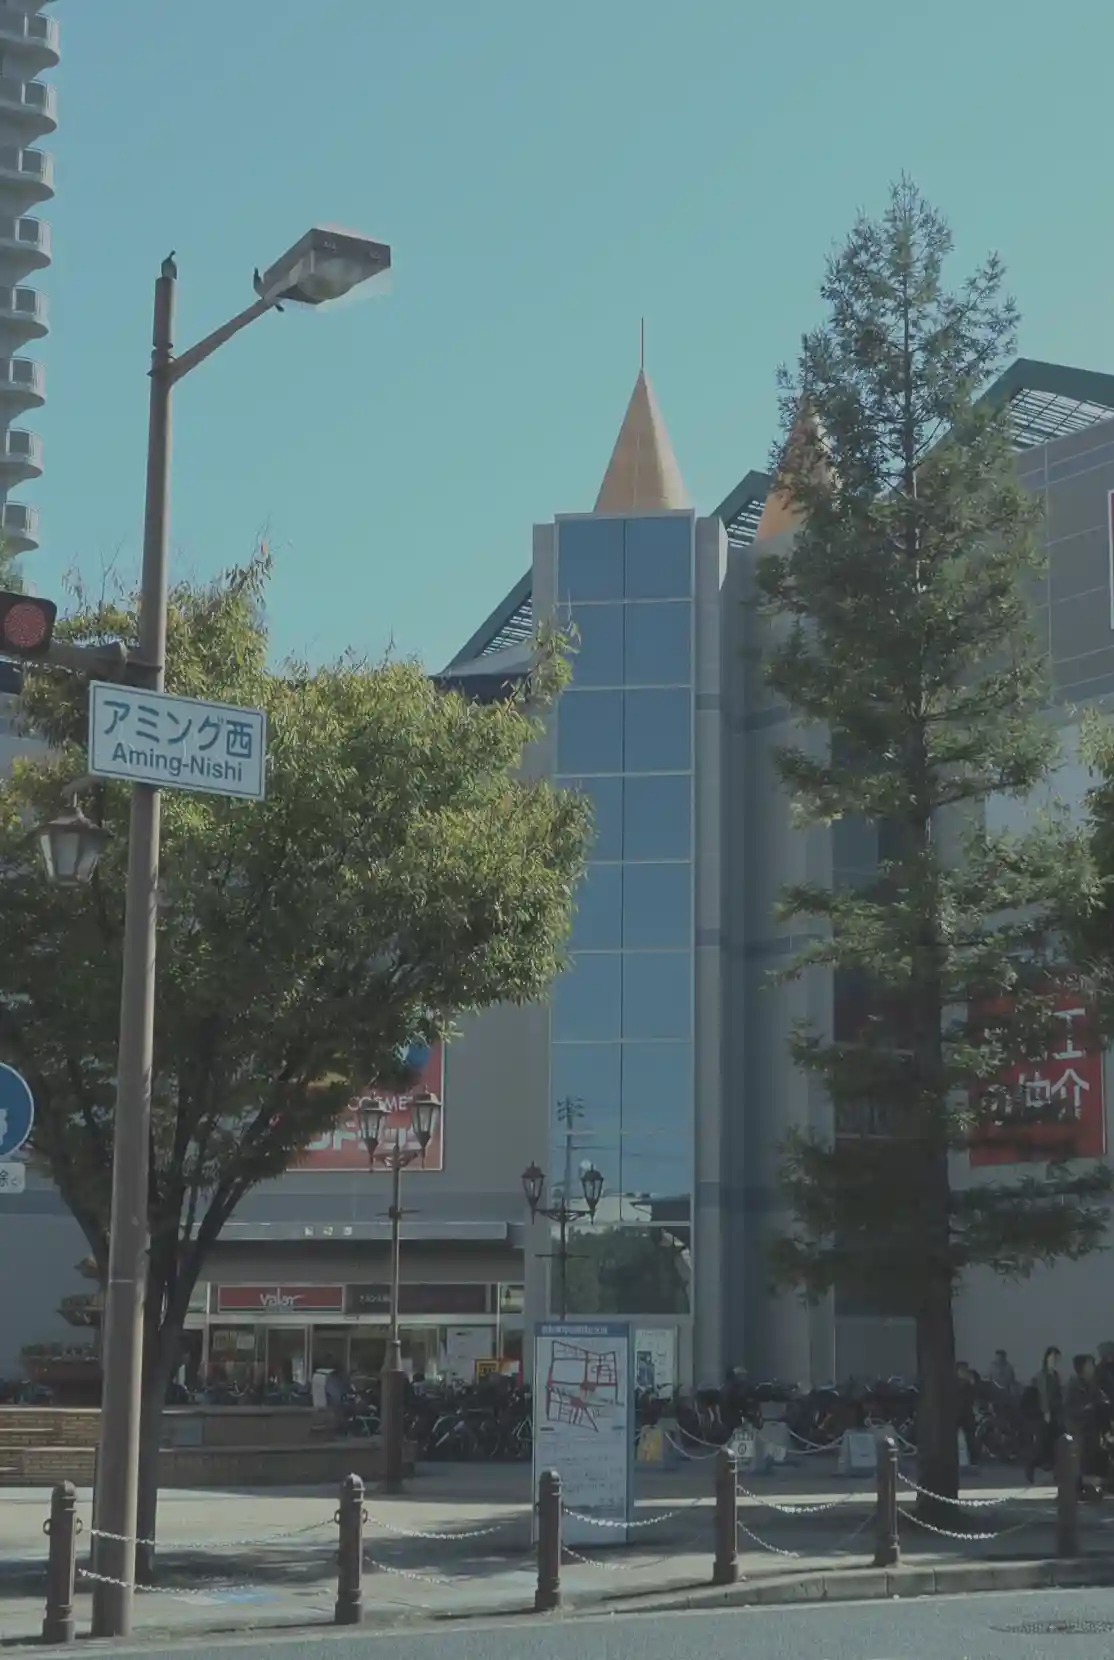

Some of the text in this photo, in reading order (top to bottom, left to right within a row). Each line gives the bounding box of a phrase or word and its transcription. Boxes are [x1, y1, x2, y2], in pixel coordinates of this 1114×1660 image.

[103, 700, 254, 759] アミング西
[111, 742, 243, 783] Aming-Nishi
